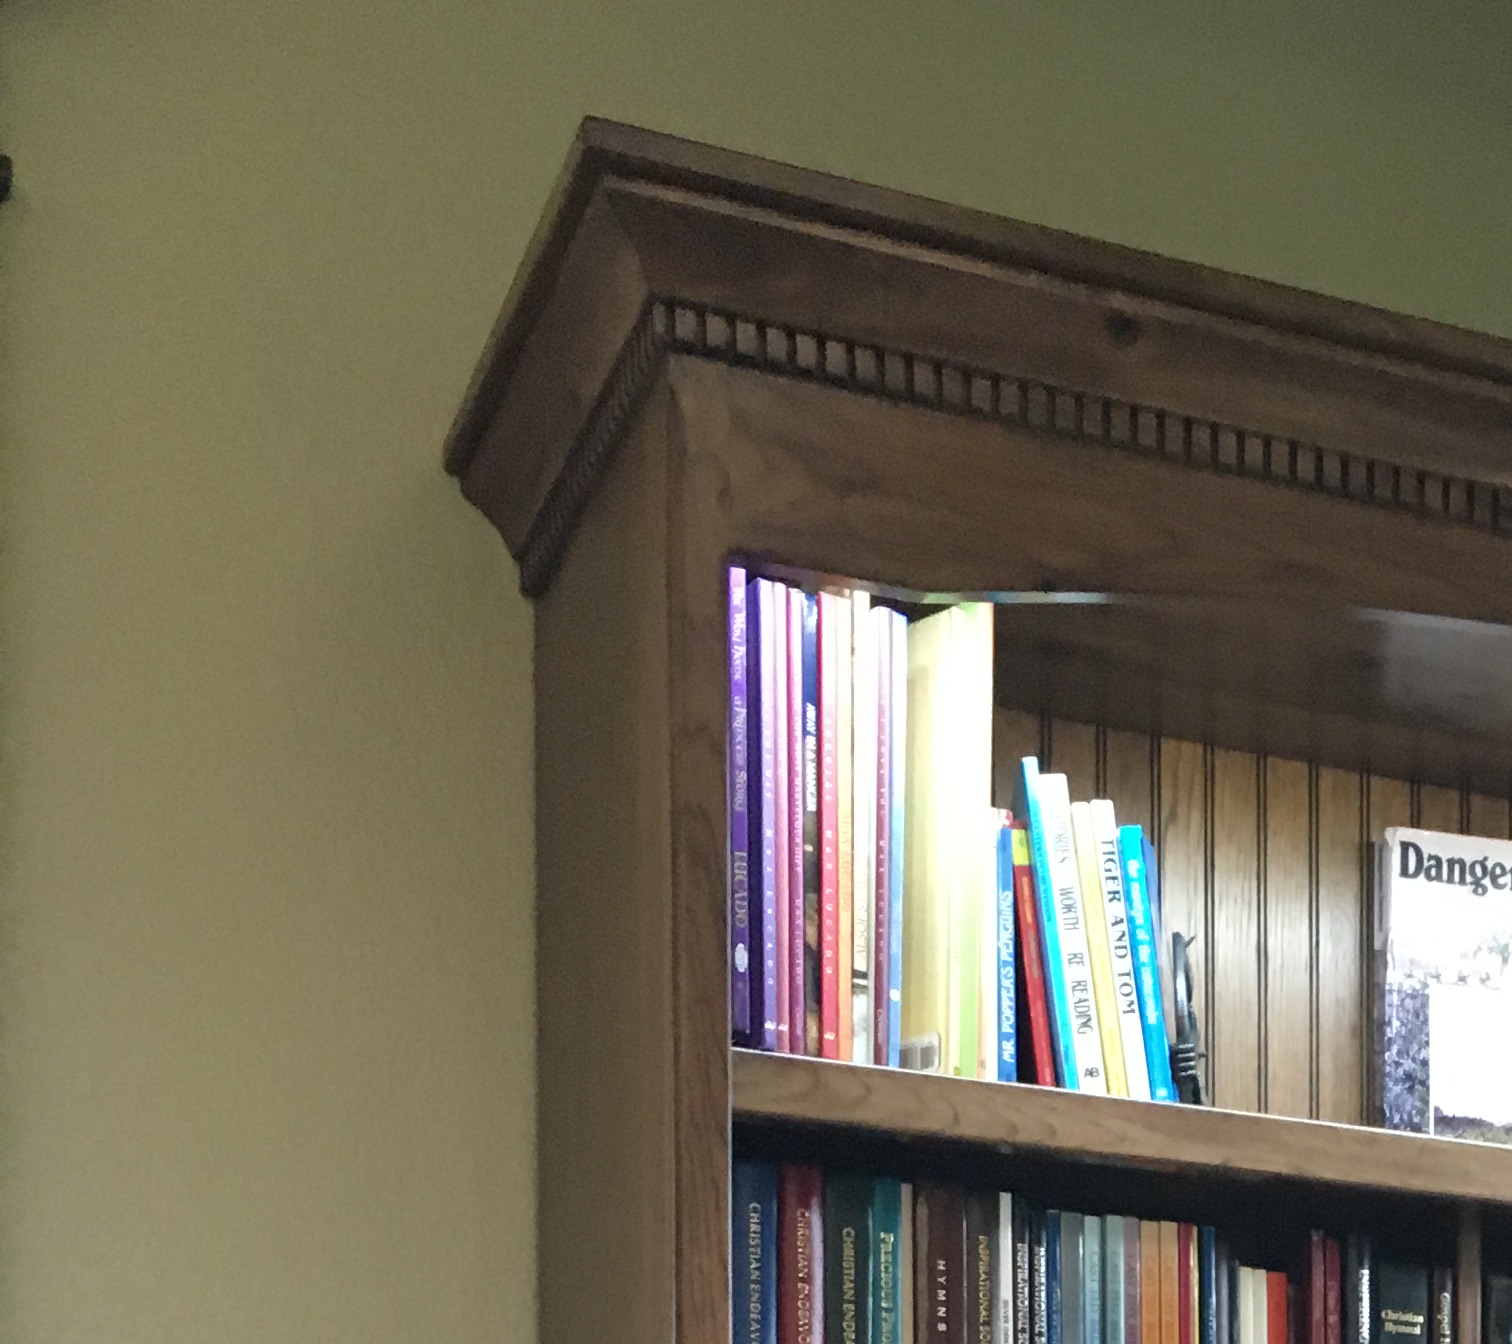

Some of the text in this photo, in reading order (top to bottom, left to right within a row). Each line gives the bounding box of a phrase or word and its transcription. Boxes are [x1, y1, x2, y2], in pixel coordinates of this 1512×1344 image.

[806, 703, 817, 734] AWAY
[806, 762, 817, 812] MANGER
[733, 851, 748, 929] LUCADO
[998, 890, 1014, 962] PENGUINS
[1099, 838, 1136, 1016] TIGER AND TOM
[1058, 886, 1094, 1035] WORTH RE READING
[998, 965, 1014, 1033] POPPER'S
[748, 1202, 762, 1281] CHRISTIAN
[796, 1207, 811, 1278] CHRISTIAN
[842, 1227, 857, 1301] CHRISTIAN
[880, 1232, 895, 1308] PRECIOUS
[979, 1236, 991, 1322] INSPIRATIONAL
[936, 1259, 948, 1332] HYMNS
[1017, 1243, 1030, 1329] INSPIRATIONAL
[1034, 1247, 1047, 1332] INSPIRATIONAL
[1437, 1291, 1451, 1335] Gospel
